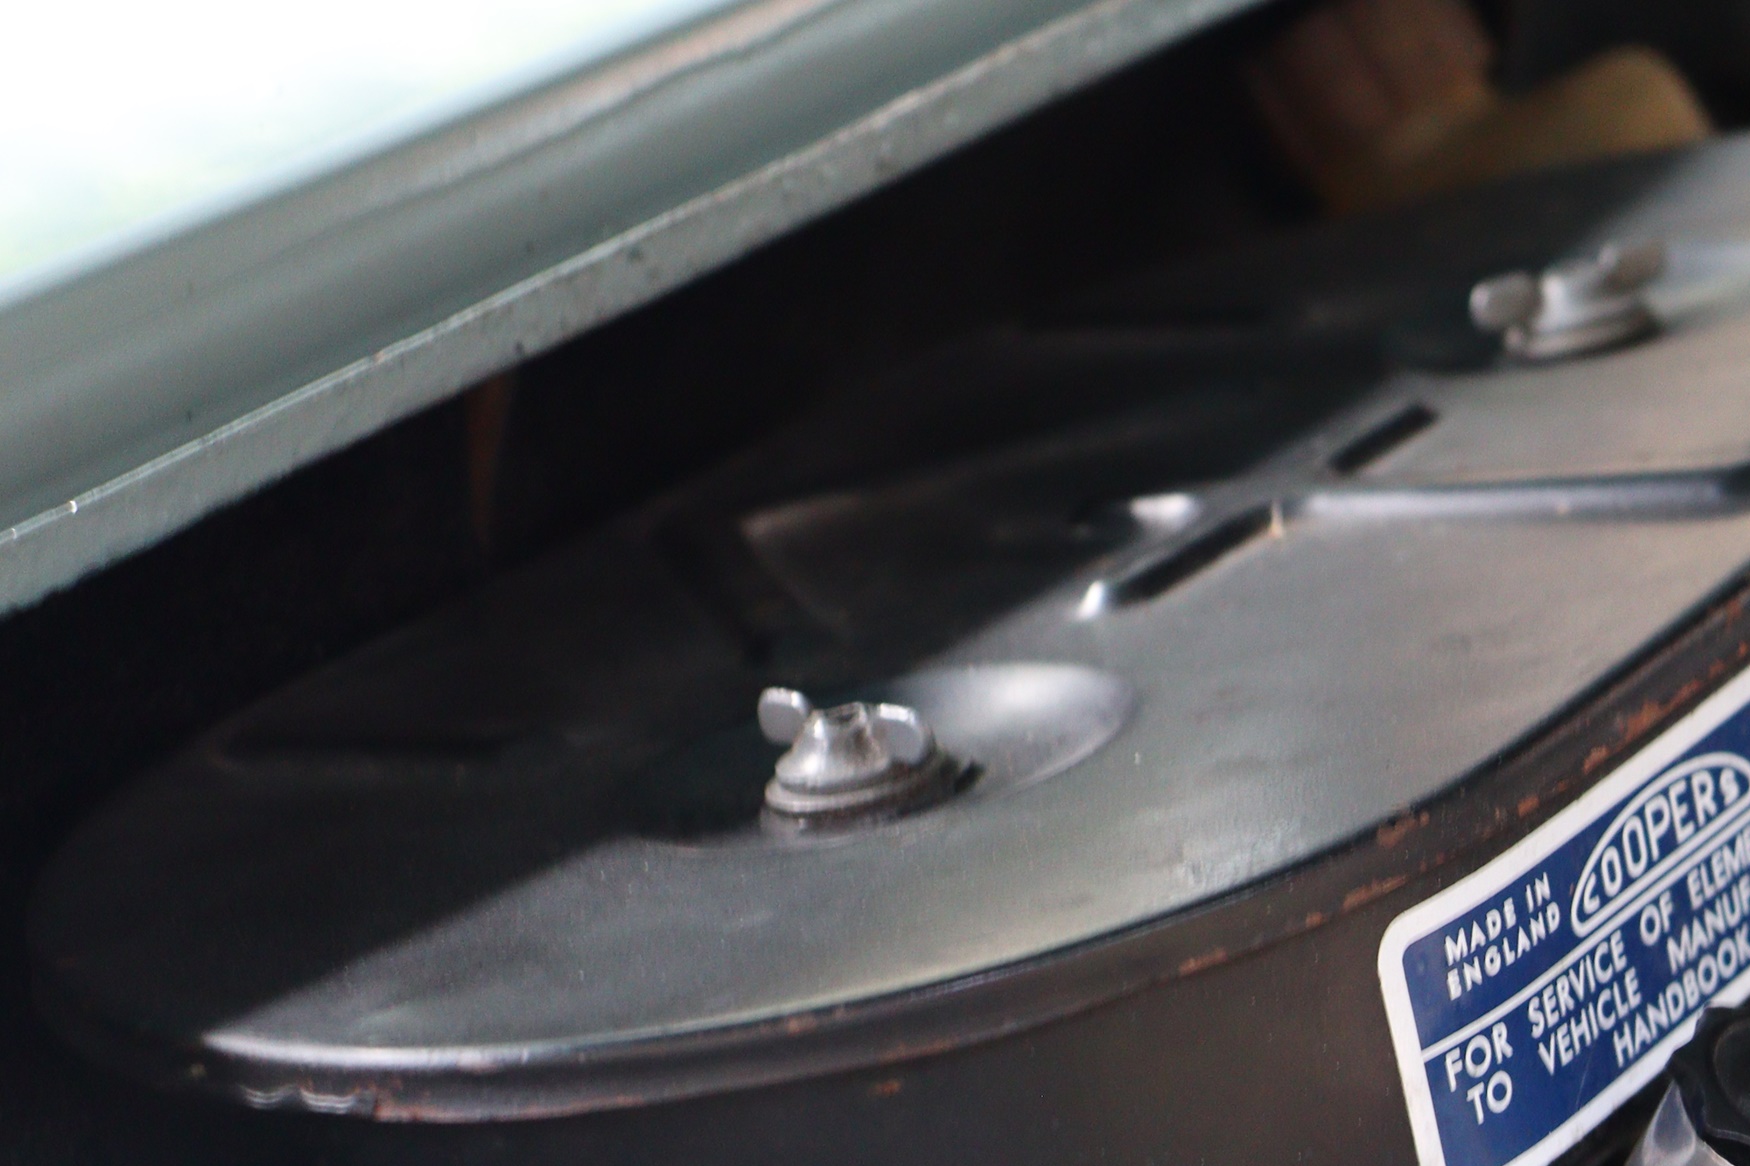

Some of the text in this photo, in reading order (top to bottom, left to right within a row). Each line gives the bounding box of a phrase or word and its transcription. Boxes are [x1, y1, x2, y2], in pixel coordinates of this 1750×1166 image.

[1582, 767, 1739, 914] COOPERS
[1444, 872, 1551, 966] MADE IN
[1447, 902, 1561, 1000] ENGLAND
[1445, 1021, 1514, 1092] FOR
[1528, 930, 1628, 1039] SERVICE
[1639, 897, 1675, 945] OF
[1467, 1071, 1513, 1125] TO
[1538, 969, 1641, 1075] VEHICLE
